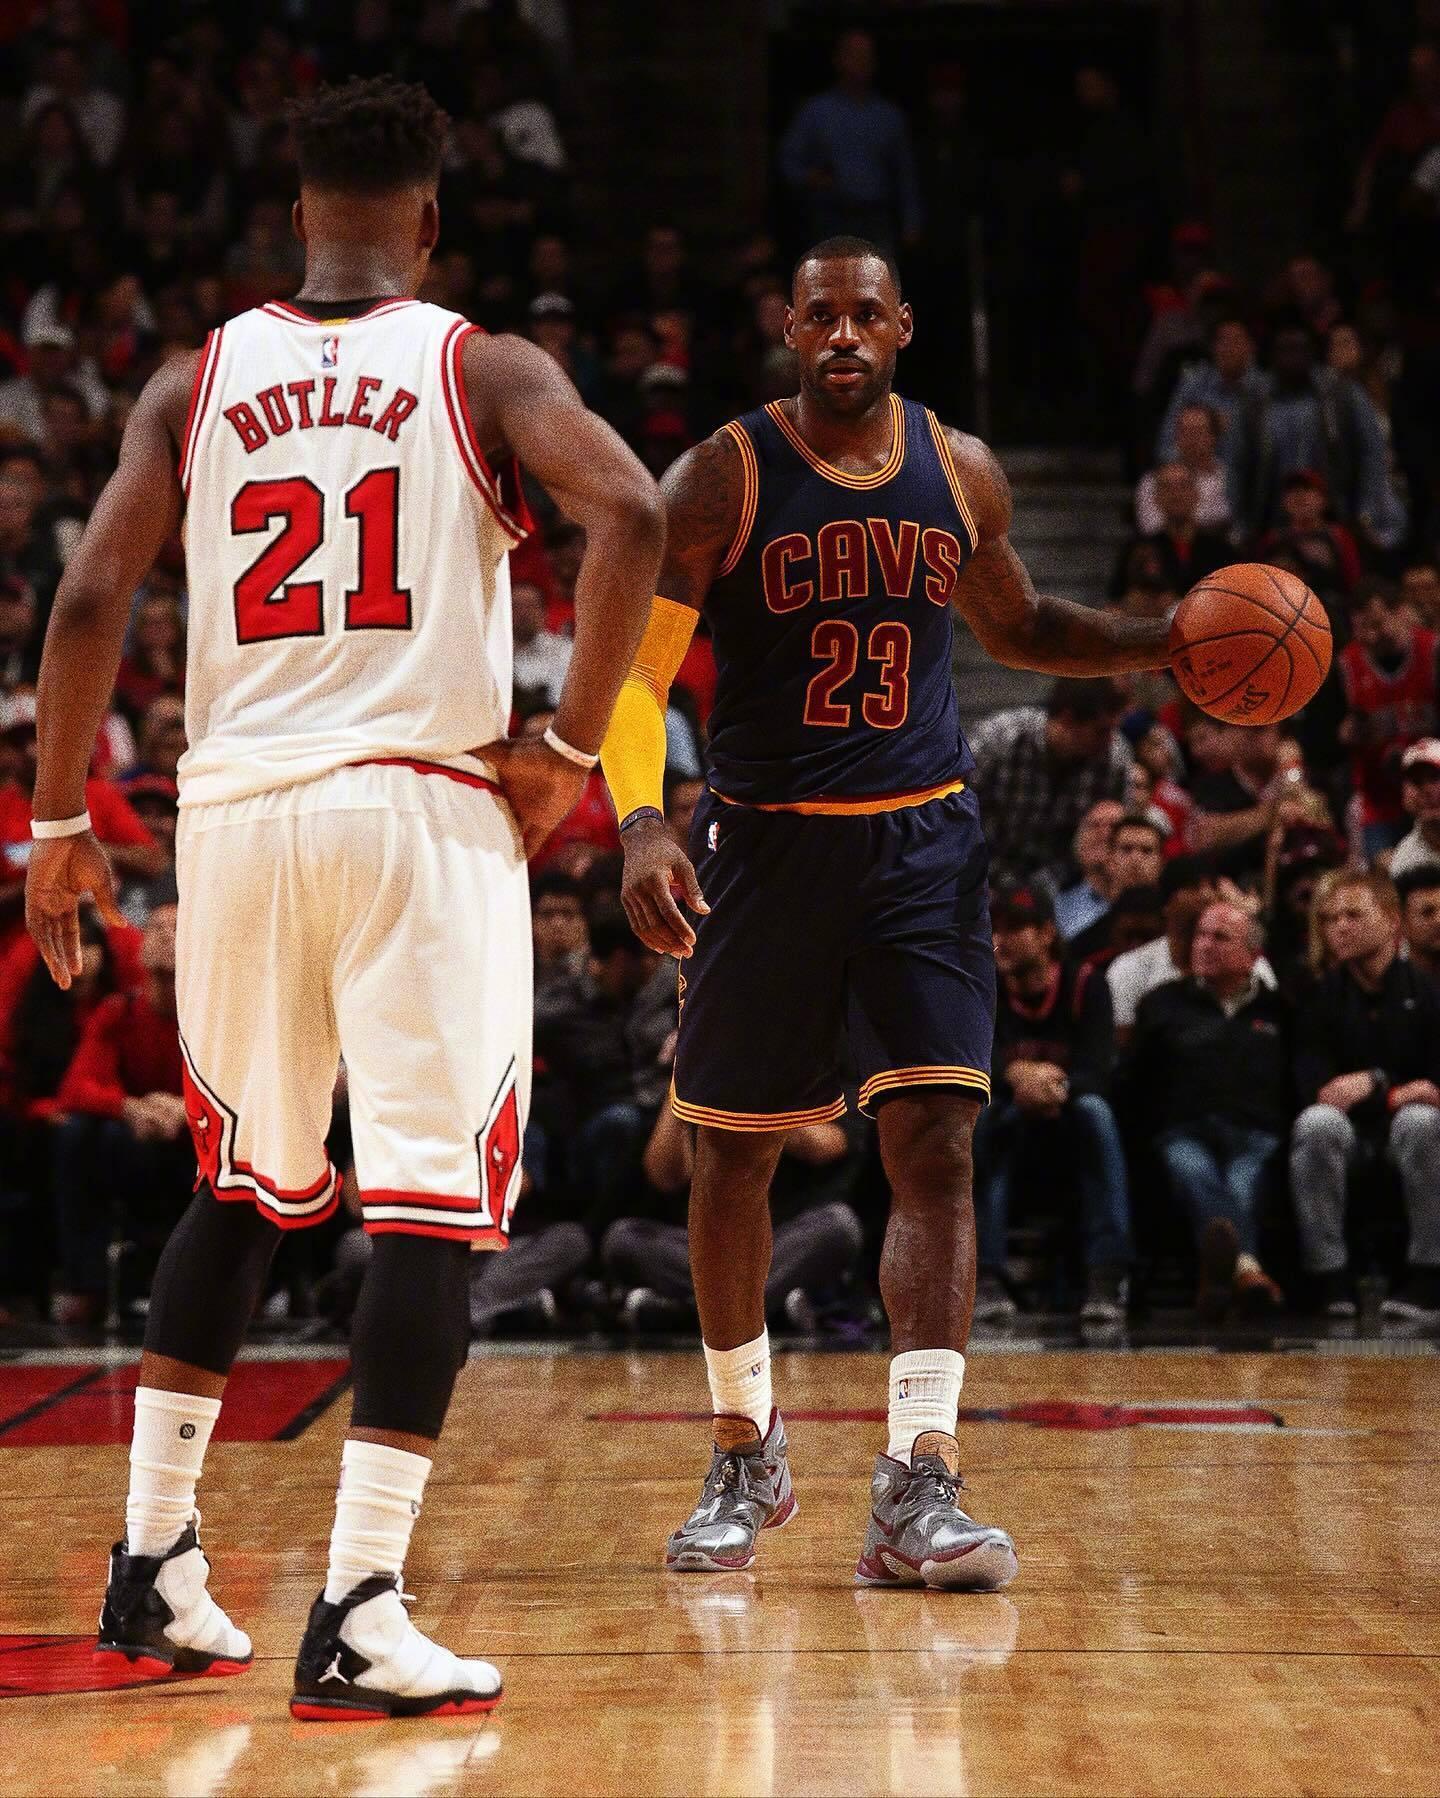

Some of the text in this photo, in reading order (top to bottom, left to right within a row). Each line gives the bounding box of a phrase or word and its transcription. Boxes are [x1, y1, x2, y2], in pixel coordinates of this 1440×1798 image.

[223, 376, 418, 454] BUTLER
[231, 466, 412, 645] 21
[762, 518, 961, 614] CAVS
[803, 620, 911, 729] 23
